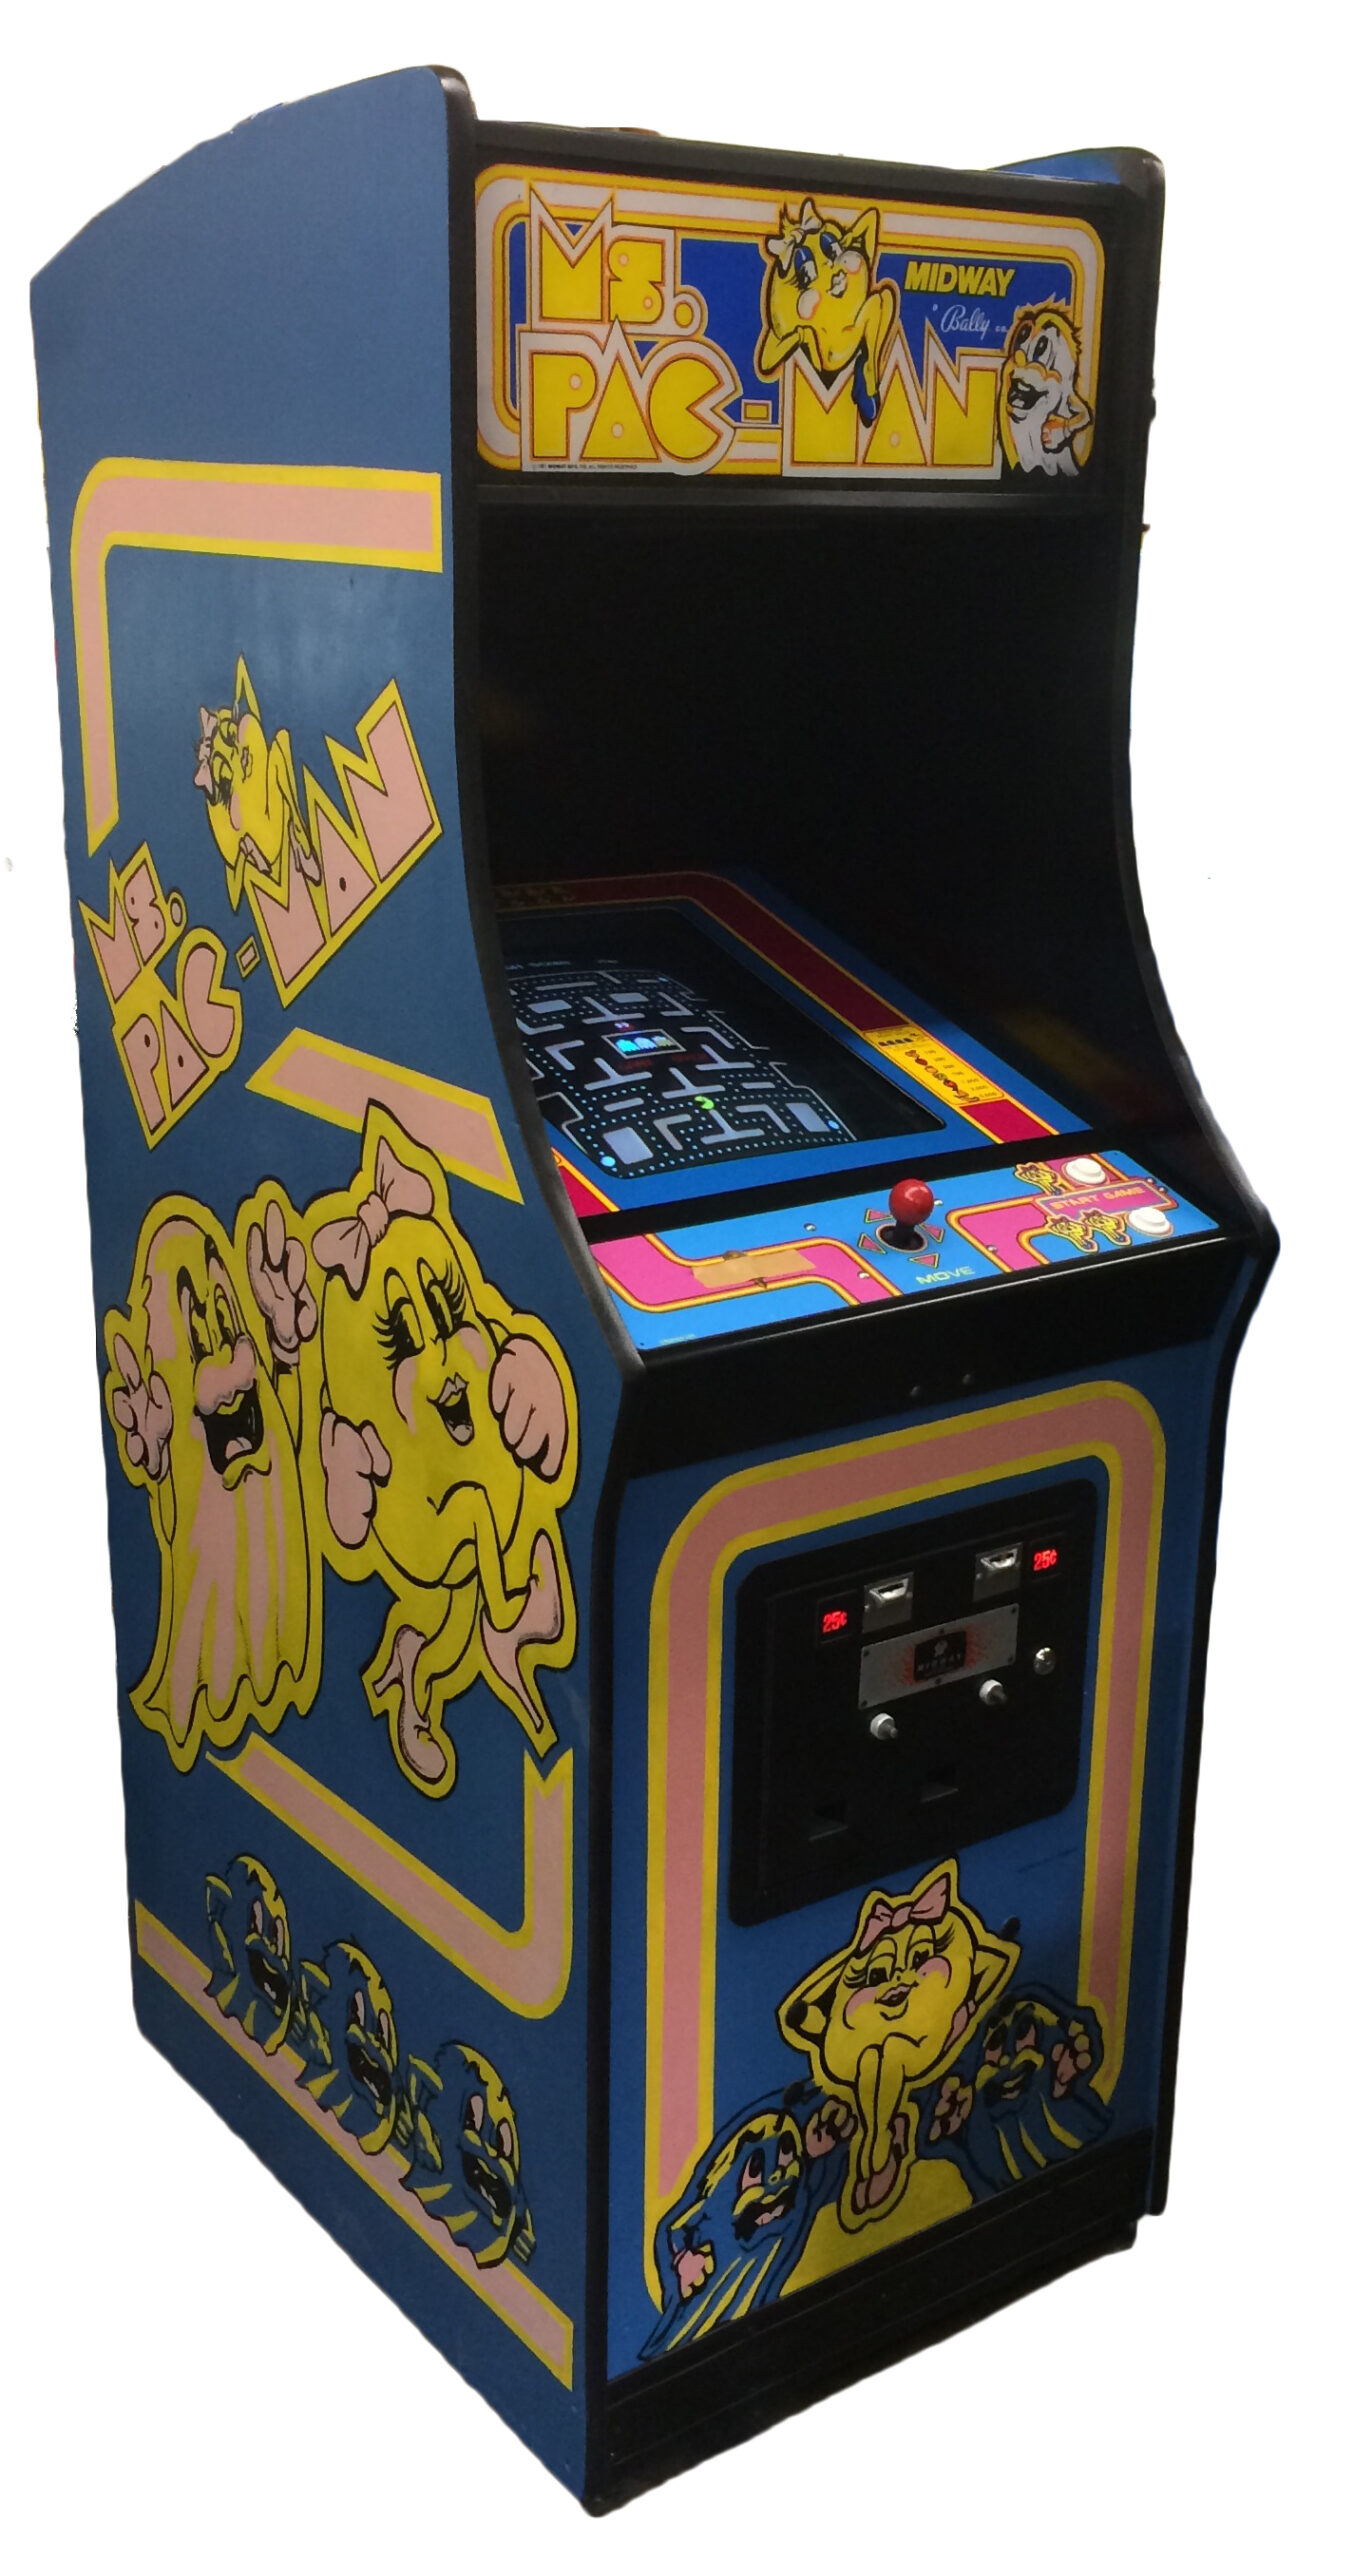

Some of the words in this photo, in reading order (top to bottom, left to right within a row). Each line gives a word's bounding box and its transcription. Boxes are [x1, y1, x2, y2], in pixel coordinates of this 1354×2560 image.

[903, 260, 1016, 298] MIDWAY
[940, 304, 992, 341] Bally
[525, 330, 1000, 471] PAC-MAN
[116, 688, 440, 1143] PAC-MAN
[1049, 1194, 1101, 1211] START
[1102, 1186, 1147, 1200] GAME
[915, 1266, 976, 1285] MOVE
[1033, 1548, 1058, 1572] 25¢
[822, 1610, 848, 1634] 25¢
